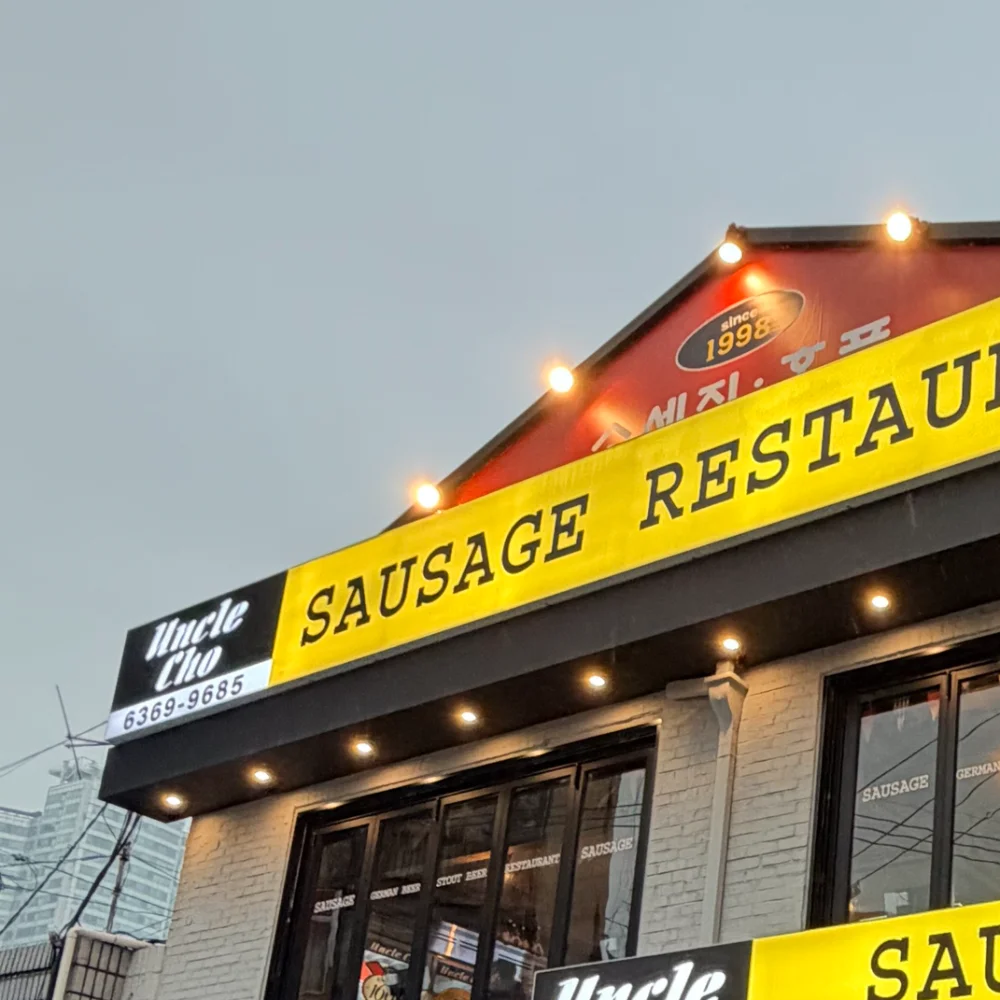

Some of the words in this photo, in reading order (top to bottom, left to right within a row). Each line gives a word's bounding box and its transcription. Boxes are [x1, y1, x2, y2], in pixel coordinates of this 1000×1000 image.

[705, 317, 774, 362] 1998
[300, 493, 590, 647] SAUSAGE
[145, 597, 249, 662] Uncle
[155, 645, 223, 692] Cho
[123, 674, 245, 730] 6369-9685
[861, 773, 929, 802] SAUSAGE
[505, 853, 561, 873] RESTAURANT
[580, 837, 633, 860] SAUSAGE
[436, 873, 463, 888] STOUT
[466, 868, 488, 882] BEER
[313, 894, 356, 914] SAUSAGE
